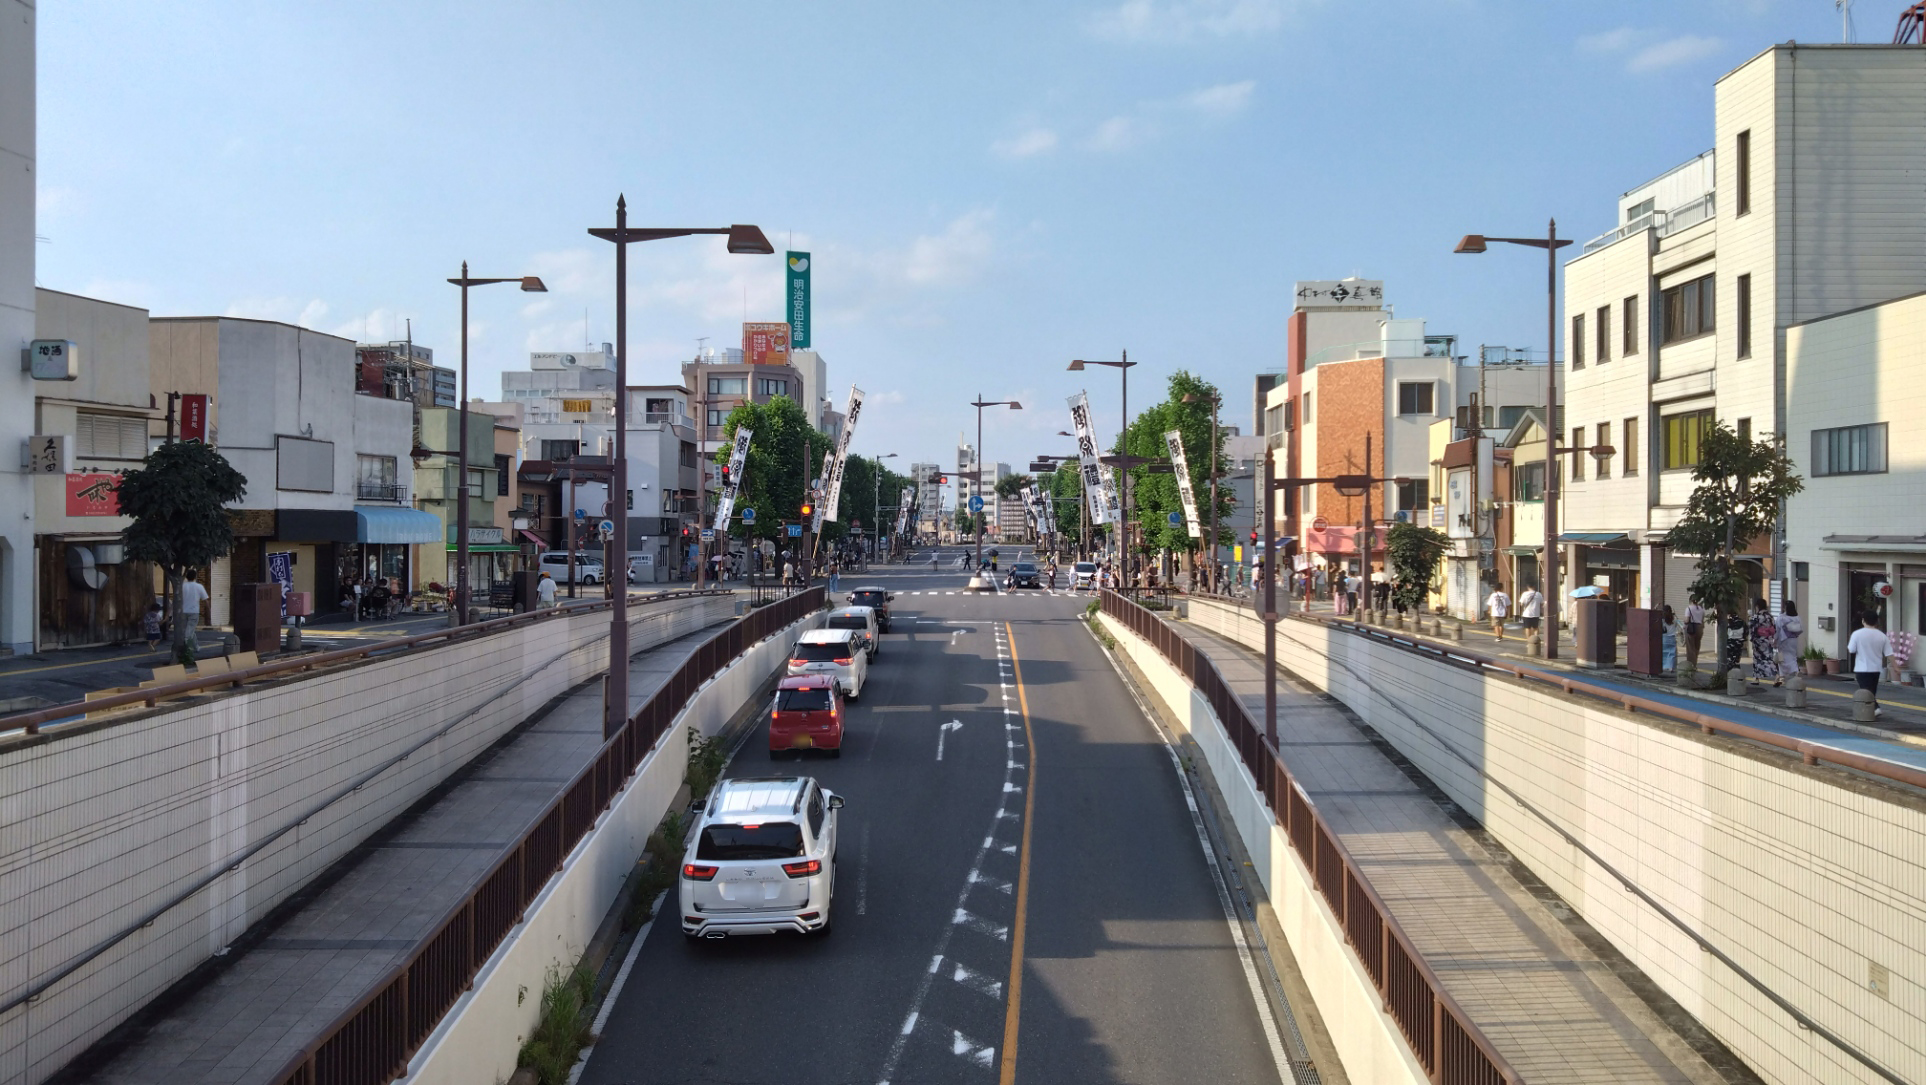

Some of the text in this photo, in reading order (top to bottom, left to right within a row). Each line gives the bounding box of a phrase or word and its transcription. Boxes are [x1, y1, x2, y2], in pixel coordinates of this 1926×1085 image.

[793, 278, 804, 341] 明治安田生命
[38, 345, 62, 356] 地酒
[41, 437, 57, 472] 久保田
